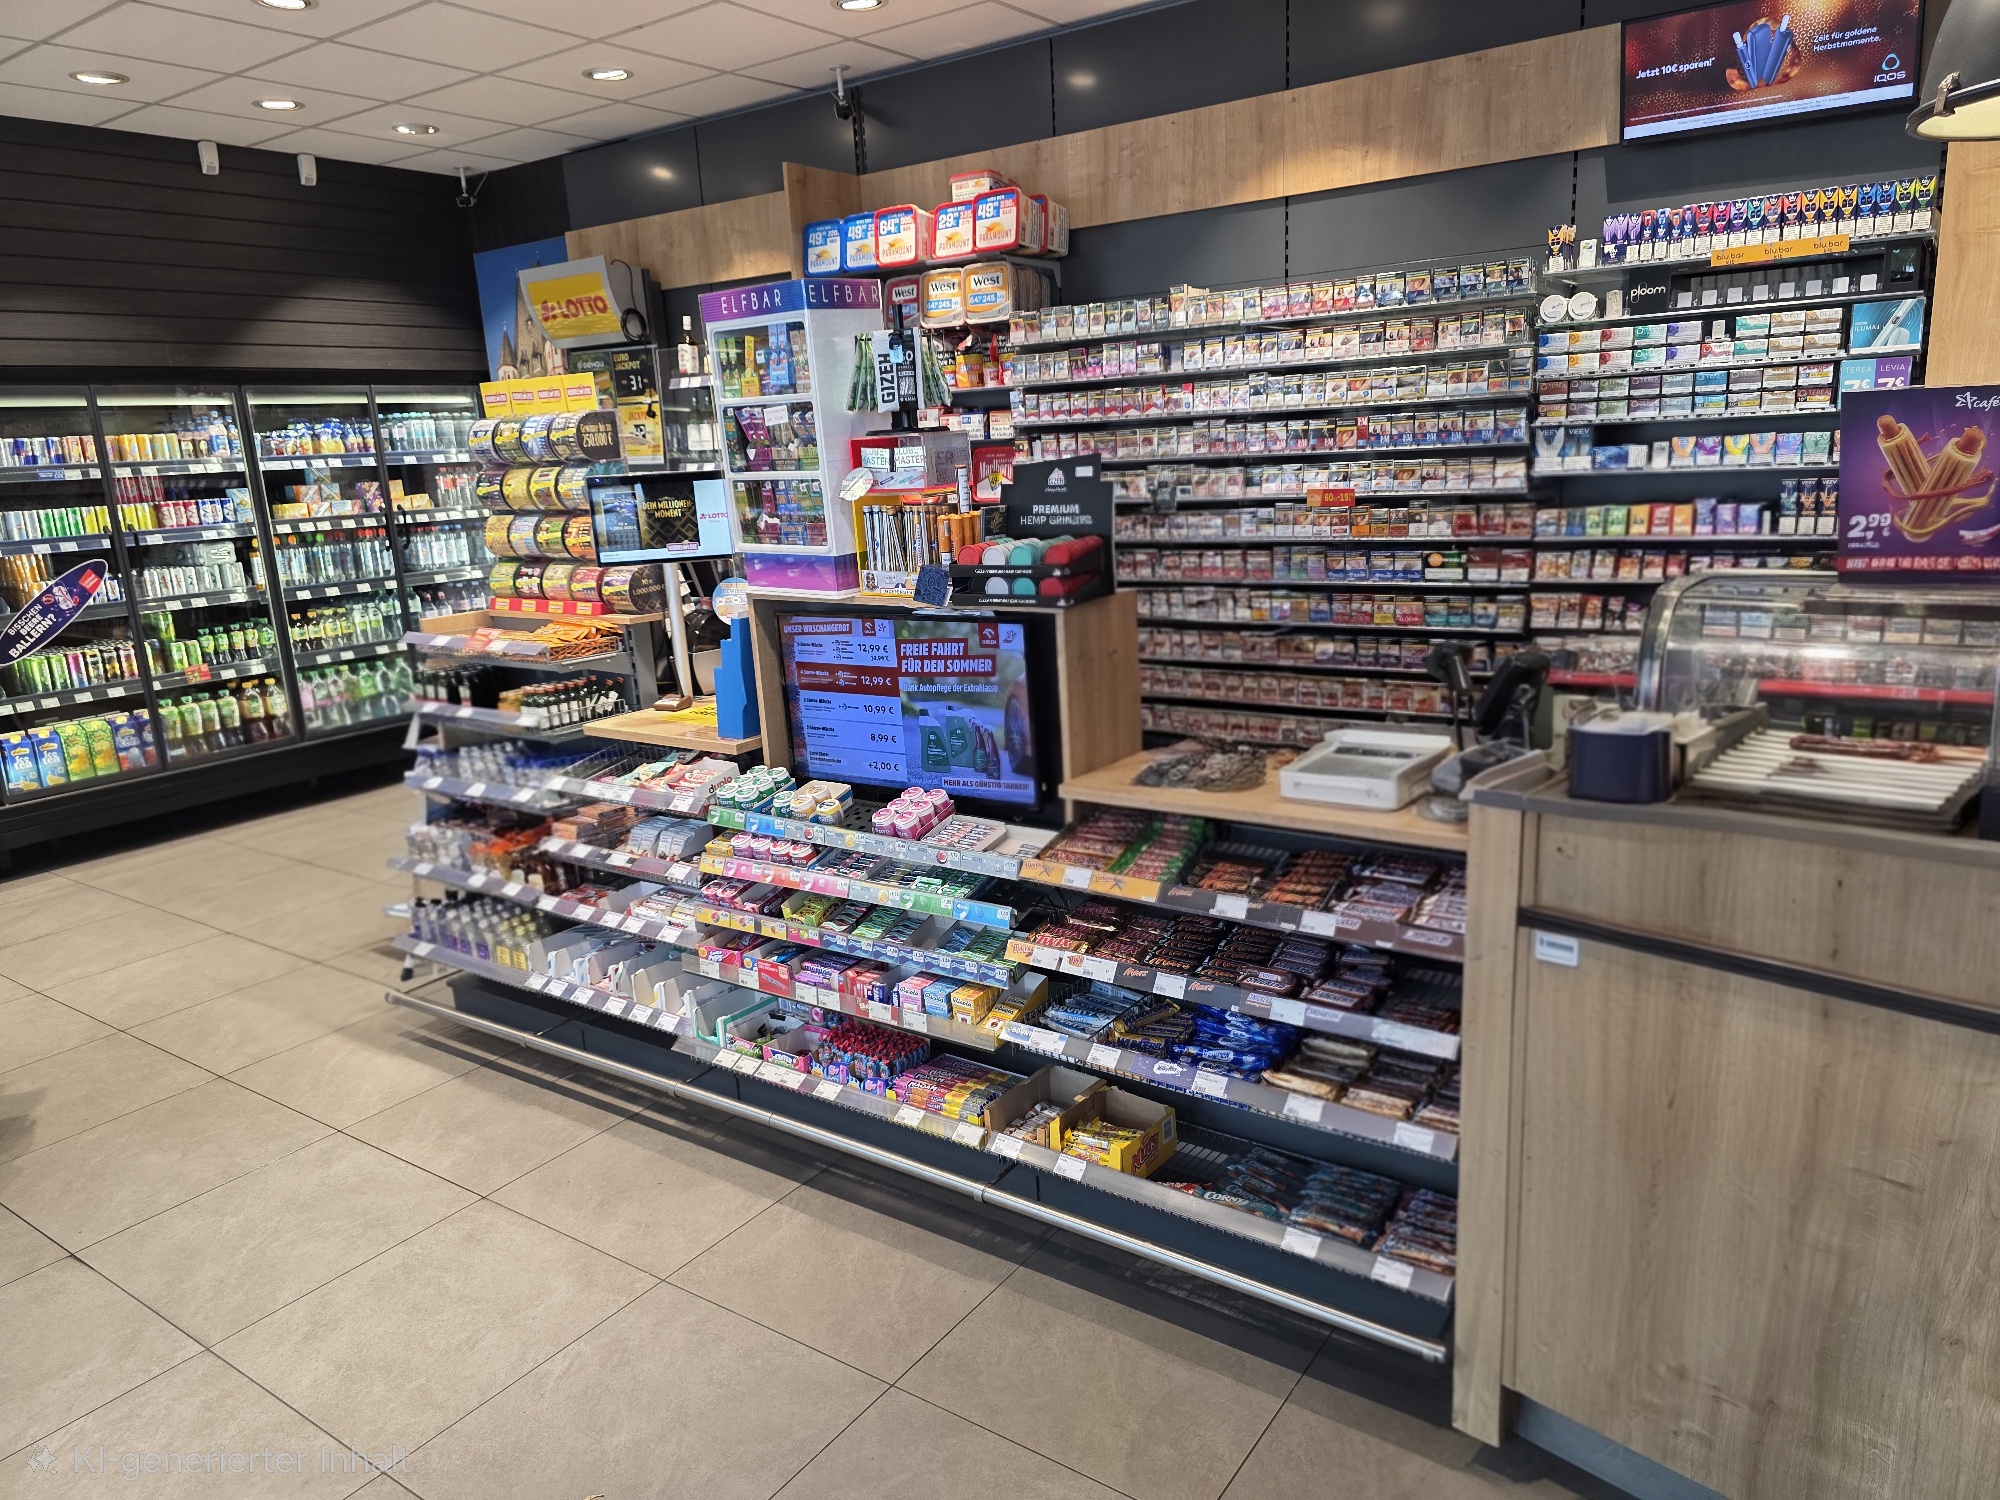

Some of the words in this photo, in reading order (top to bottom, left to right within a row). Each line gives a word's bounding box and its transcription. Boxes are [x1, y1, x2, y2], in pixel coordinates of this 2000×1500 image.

[1812, 33, 1830, 44] Zeit
[1831, 31, 1844, 41] für
[1844, 27, 1878, 40] goldene
[1813, 35, 1882, 52] Herbstmomente.
[1636, 67, 1660, 79] Jetzt
[1661, 64, 1678, 75] 10€
[1873, 71, 1907, 83] IQOS
[980, 229, 1012, 242] PARAMOUNT
[882, 244, 912, 256] PARAMOUNT
[938, 238, 970, 251] PARAMOUNT
[1814, 240, 1844, 249] blu.bar
[1764, 246, 1793, 255] blu.bar
[810, 257, 838, 268] PARAMOUNT
[974, 274, 1000, 286] West
[894, 286, 916, 298] West
[930, 281, 956, 292] West
[809, 284, 879, 304] ELFBAR
[721, 288, 782, 314] ELFBAR
[557, 295, 608, 319] LOTTO
[615, 361, 640, 371] JACKPOT
[1846, 366, 1872, 374] TEREA
[1880, 364, 1906, 372] LEVIA
[878, 354, 896, 404] GIZEH
[642, 500, 656, 510] DEIN
[1032, 504, 1080, 514] PREMIUM
[654, 508, 682, 518] MOMENT
[1020, 516, 1046, 525] HEMP
[8, 604, 42, 637] BISSCHEN
[18, 612, 44, 636] BEERE
[784, 625, 802, 633] UNSER
[803, 623, 850, 632] WASCHANGEBOT
[8, 613, 58, 659] BALLERN?
[858, 644, 880, 654] 12,99
[882, 644, 888, 653] €
[900, 643, 928, 656] FREIE
[931, 642, 964, 656] FAHRT
[902, 658, 922, 672] FÜR
[924, 659, 945, 672] DEN
[946, 658, 992, 672] SOMMER
[860, 676, 884, 686] 12,99
[886, 677, 891, 686] €
[904, 684, 918, 692] Dank
[920, 684, 952, 694] Autopflege
[952, 684, 962, 692] der
[964, 684, 998, 693] Extraklasse
[864, 704, 886, 714] 10,99
[889, 706, 894, 714] €
[870, 734, 888, 743] 8,99
[868, 762, 891, 771] +2,00
[708, 776, 733, 794] duplo
[975, 780, 1001, 788] GÜNSTIG
[1036, 934, 1072, 948] TWIX
[1123, 967, 1148, 977] Mars
[900, 987, 918, 996] Ricola
[1188, 981, 1214, 992] Mars
[952, 997, 972, 1007] Ricola
[1249, 994, 1272, 1004] SNICKERS
[908, 1081, 938, 1092] MAOAM
[1204, 1192, 1249, 1206] CORNY
